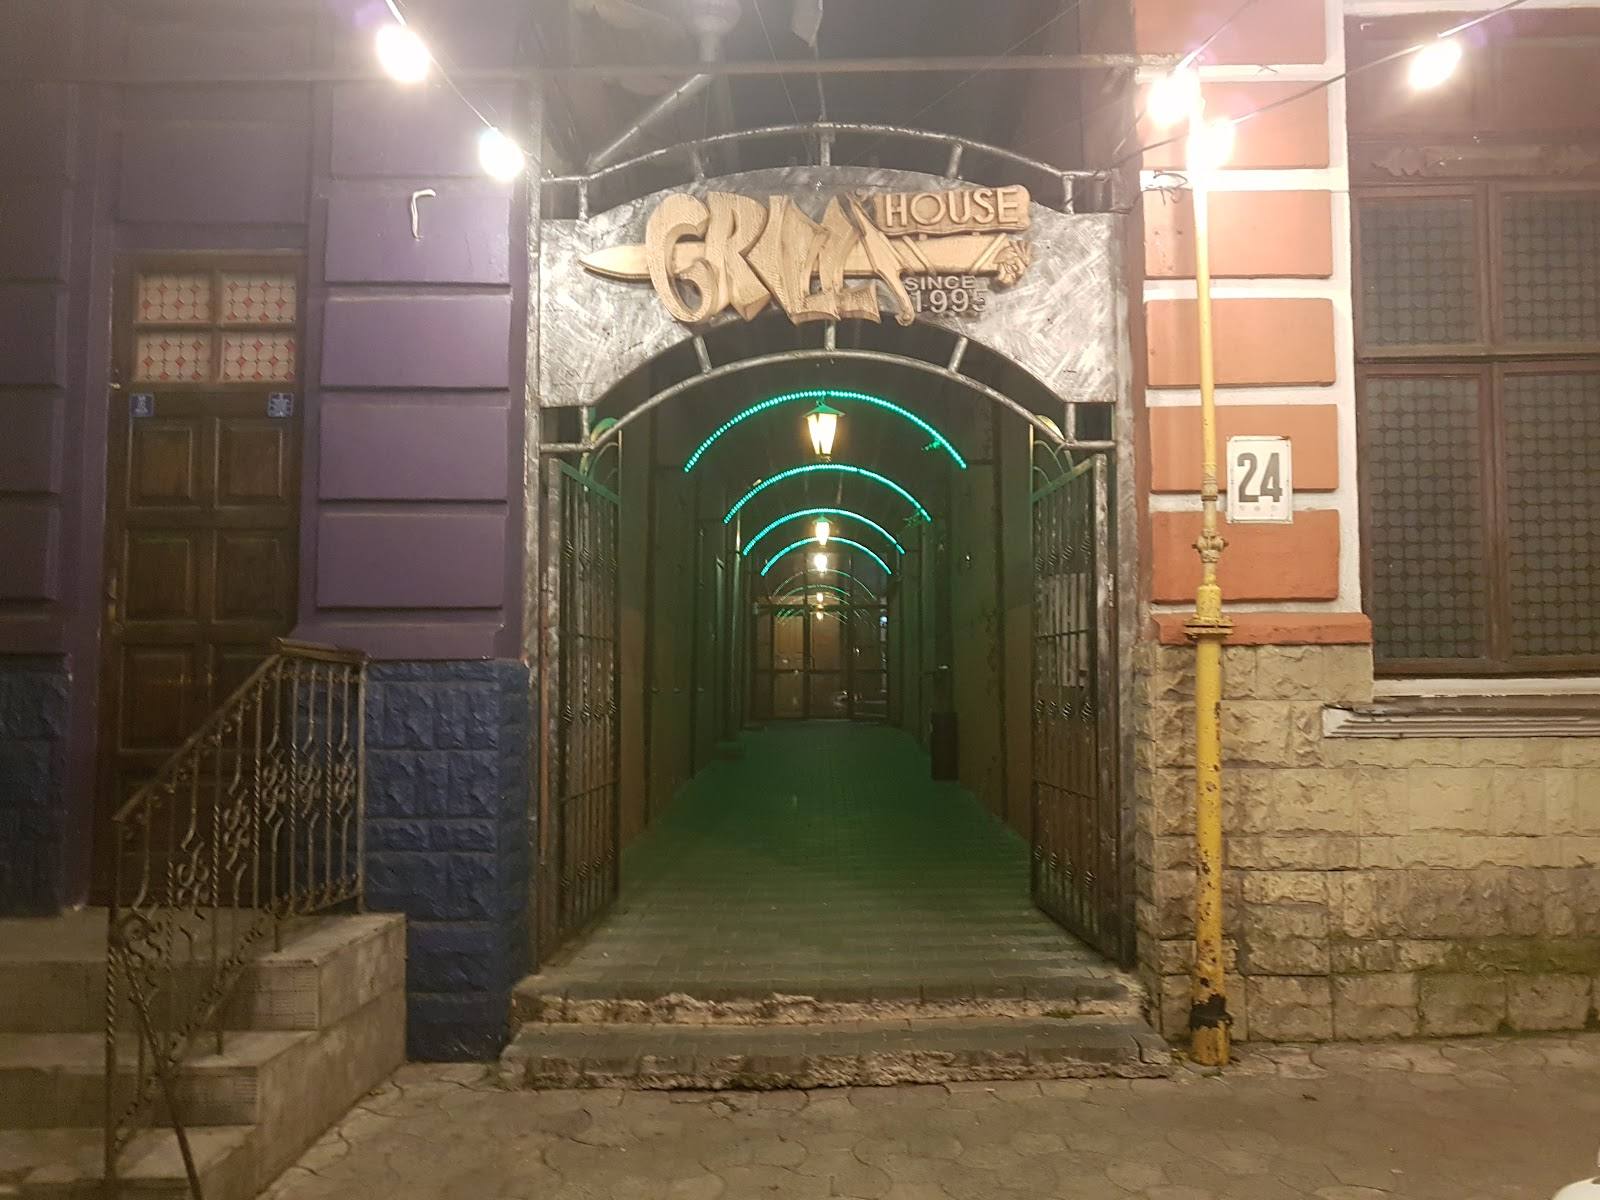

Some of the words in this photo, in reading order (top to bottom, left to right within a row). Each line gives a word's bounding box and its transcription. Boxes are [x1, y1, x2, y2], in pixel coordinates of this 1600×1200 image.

[885, 187, 1020, 227] HOUSE
[903, 275, 977, 290] SINCE
[911, 288, 988, 314] 1995
[1237, 452, 1283, 503] 24
